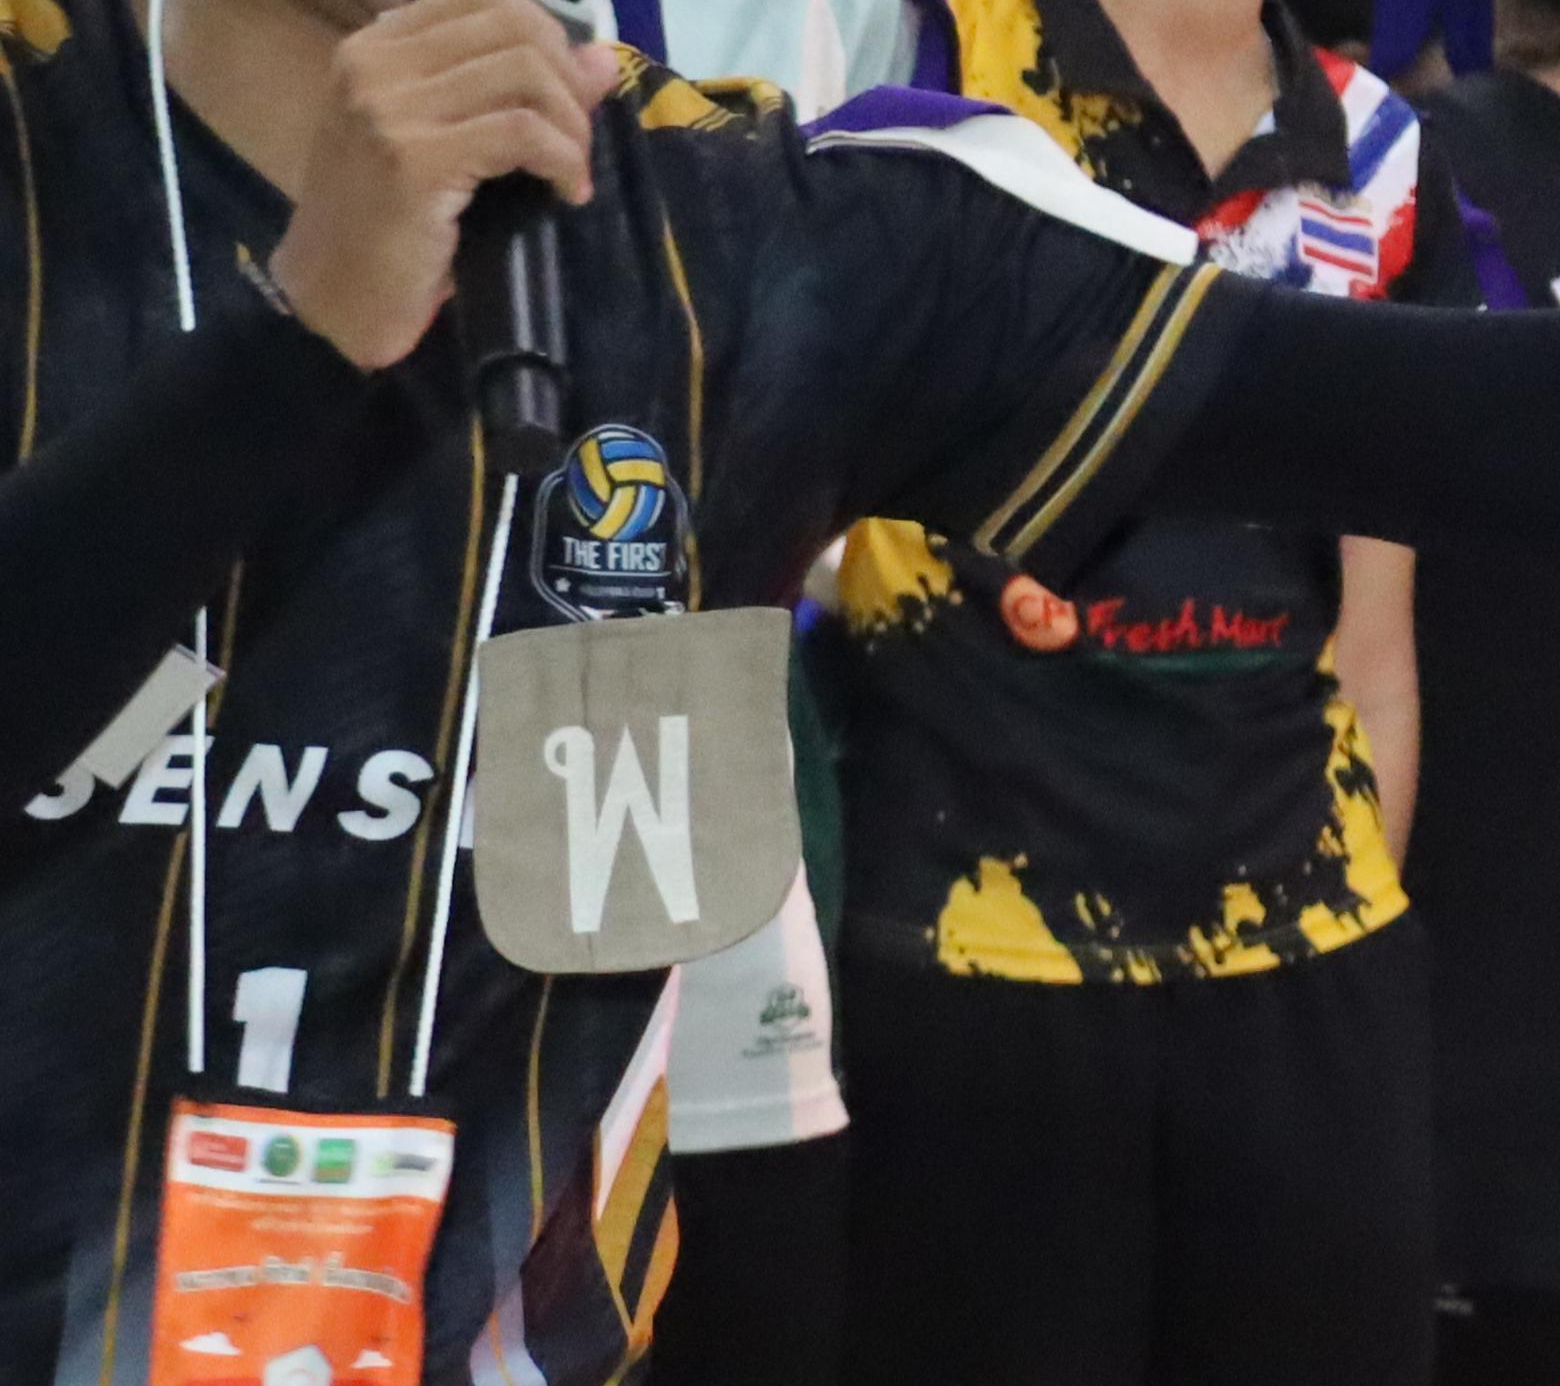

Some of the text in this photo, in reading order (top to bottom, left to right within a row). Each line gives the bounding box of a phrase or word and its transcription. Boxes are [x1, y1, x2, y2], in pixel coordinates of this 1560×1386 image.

[562, 536, 668, 572] THE FIRST
[233, 967, 308, 1094] 1
